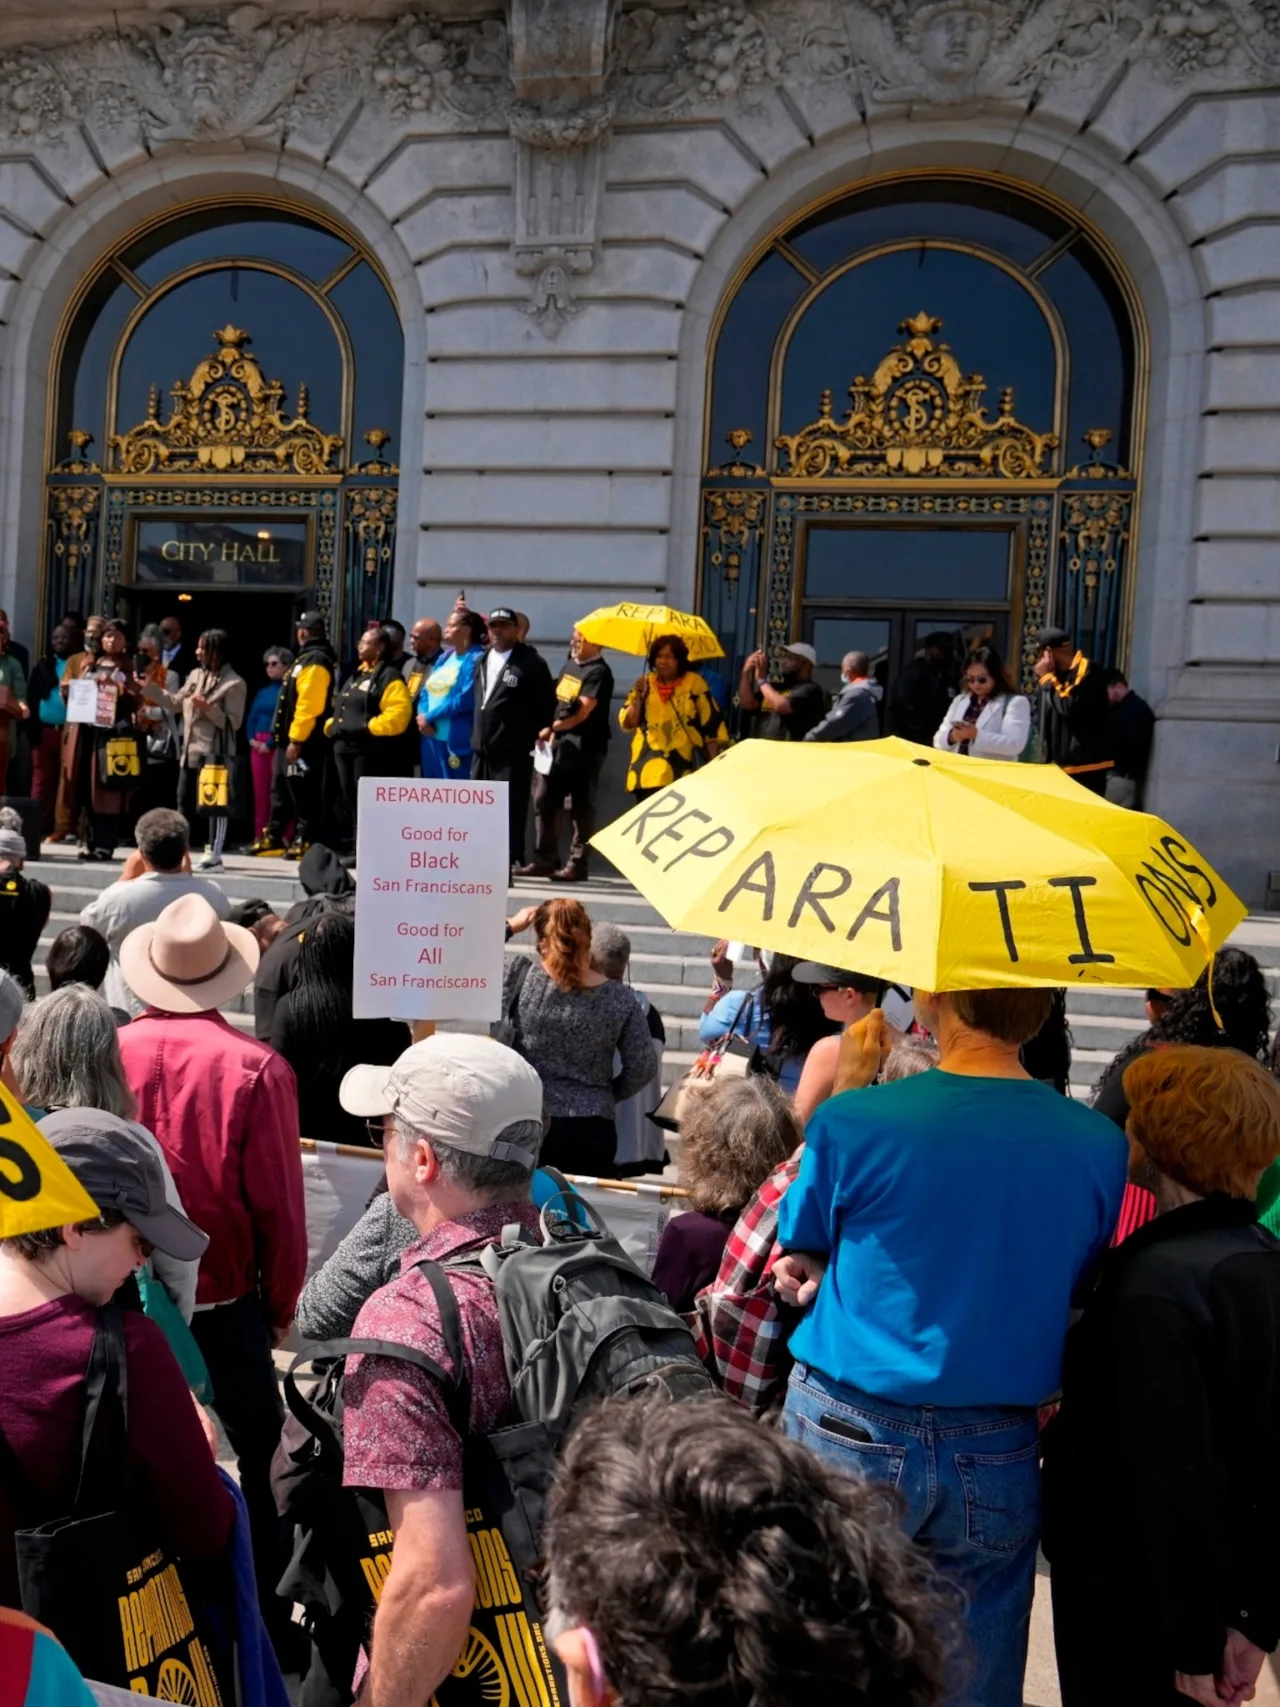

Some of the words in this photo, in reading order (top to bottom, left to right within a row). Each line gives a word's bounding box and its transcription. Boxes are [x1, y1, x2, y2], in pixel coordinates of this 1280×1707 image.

[161, 540, 215, 562] CITY
[221, 542, 280, 563] HALL
[376, 786, 495, 805] REPARATIONS
[401, 826, 442, 841] Good
[448, 826, 469, 842] for
[410, 852, 459, 869] Black
[373, 878, 400, 892] San
[406, 879, 492, 895] Franciscans
[397, 922, 438, 937] Good
[444, 923, 464, 937] for
[418, 947, 442, 965] All
[370, 973, 397, 987] San
[402, 974, 487, 989] Franciscans
